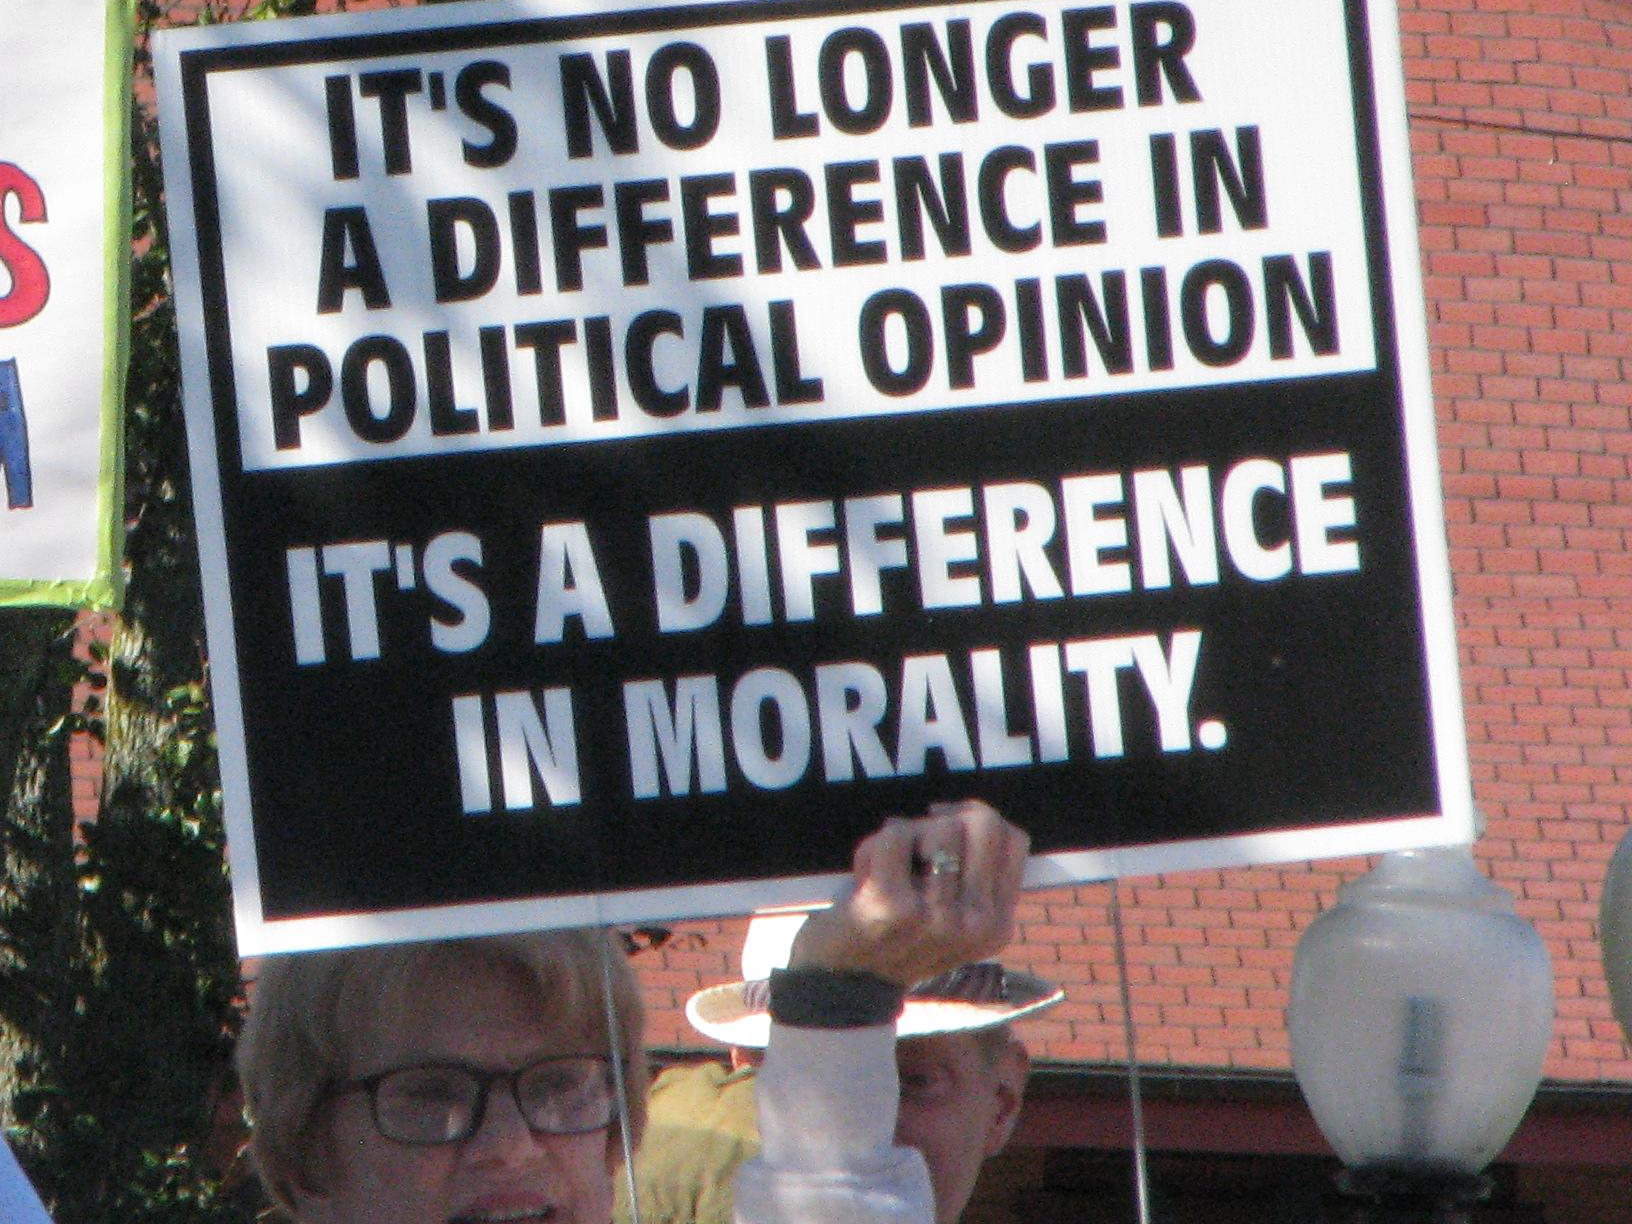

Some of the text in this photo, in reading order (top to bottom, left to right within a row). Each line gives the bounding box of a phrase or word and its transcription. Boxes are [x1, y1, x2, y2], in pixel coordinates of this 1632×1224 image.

[326, 2, 1199, 180] IT'S NO LONGER
[318, 127, 1265, 312] A DIFFERENCE IN
[268, 253, 1337, 449] POLITICAL OPINION
[287, 451, 1360, 664] IT'S A DIFFERENCE
[453, 630, 1227, 813] IN MORALITY.
